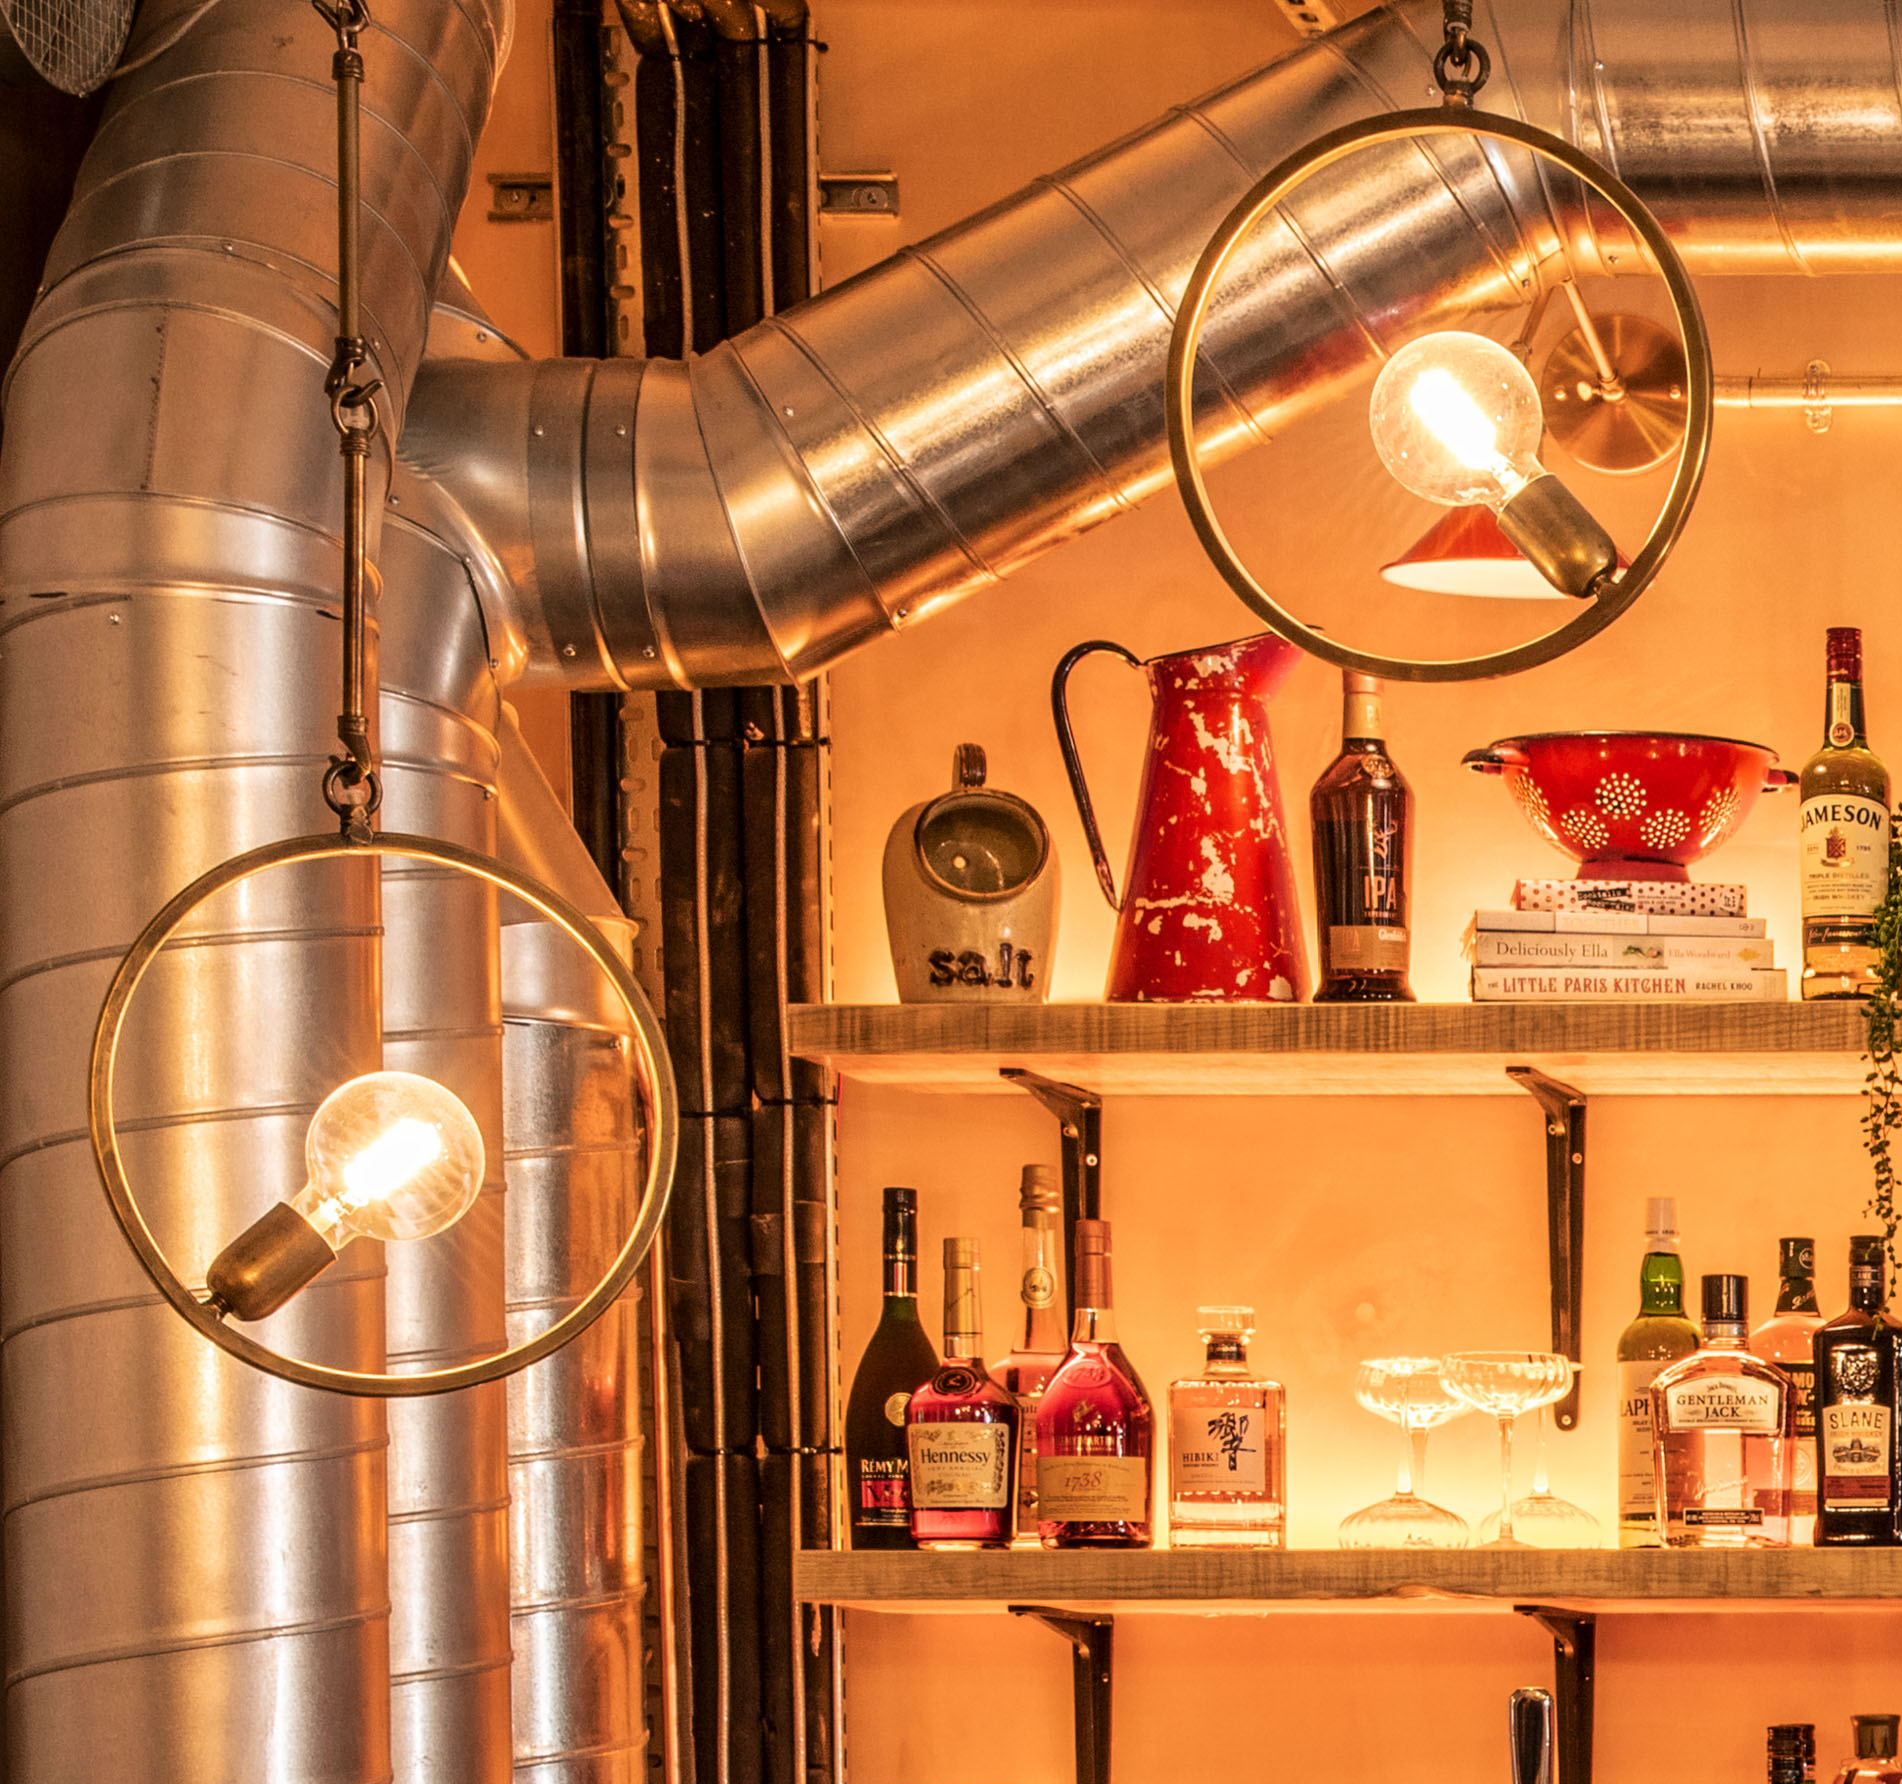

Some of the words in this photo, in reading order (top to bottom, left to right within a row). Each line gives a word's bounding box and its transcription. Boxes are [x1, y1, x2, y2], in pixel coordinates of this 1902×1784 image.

[1800, 804, 1883, 833] JAMESON
[1362, 876, 1398, 911] IPA
[1496, 940, 1574, 962] Deliciously
[1581, 940, 1608, 958] Ella
[928, 942, 1035, 989] salt
[1502, 977, 1558, 993] LITTLE
[1563, 977, 1609, 993] PARIS
[1613, 977, 1686, 994] KITCHEN
[1695, 981, 1727, 991] RACHEL
[1730, 982, 1753, 991] KHOO
[1676, 1394, 1769, 1408] GENTLEMAN
[1705, 1406, 1742, 1419] JACK
[1830, 1411, 1883, 1431] SLANE
[861, 1459, 894, 1474] RÉMY
[921, 1447, 990, 1468] Hennessy
[1182, 1451, 1220, 1463] HIBIKI
[1064, 1471, 1104, 1489] 1738
